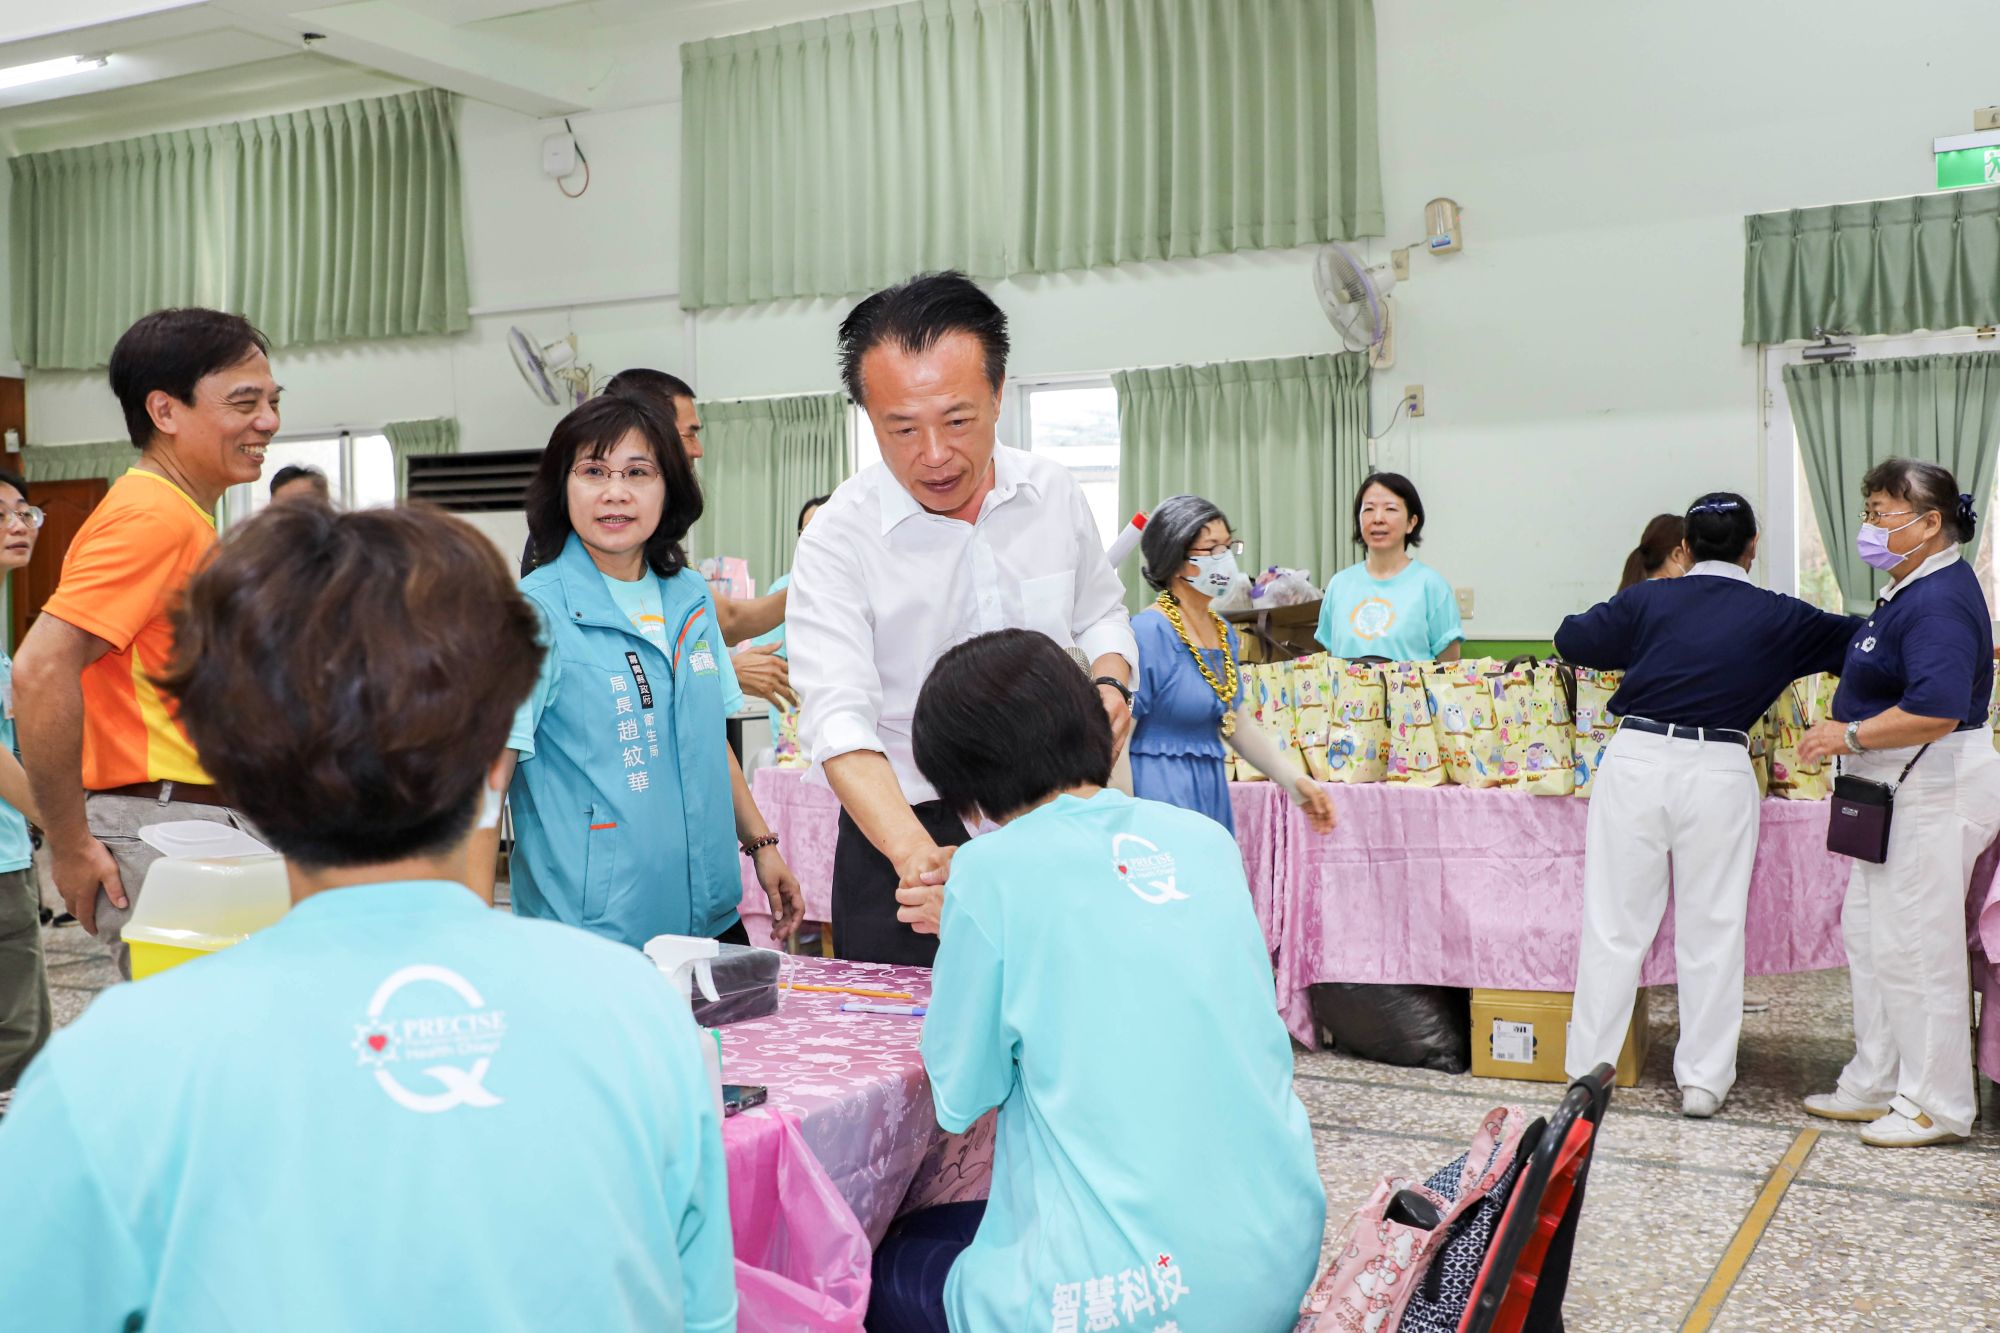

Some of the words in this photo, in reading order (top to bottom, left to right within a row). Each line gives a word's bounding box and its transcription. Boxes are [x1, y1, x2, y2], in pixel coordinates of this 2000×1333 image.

[609, 674, 649, 793] 局長趙紋華
[643, 712, 659, 760] 衛生局
